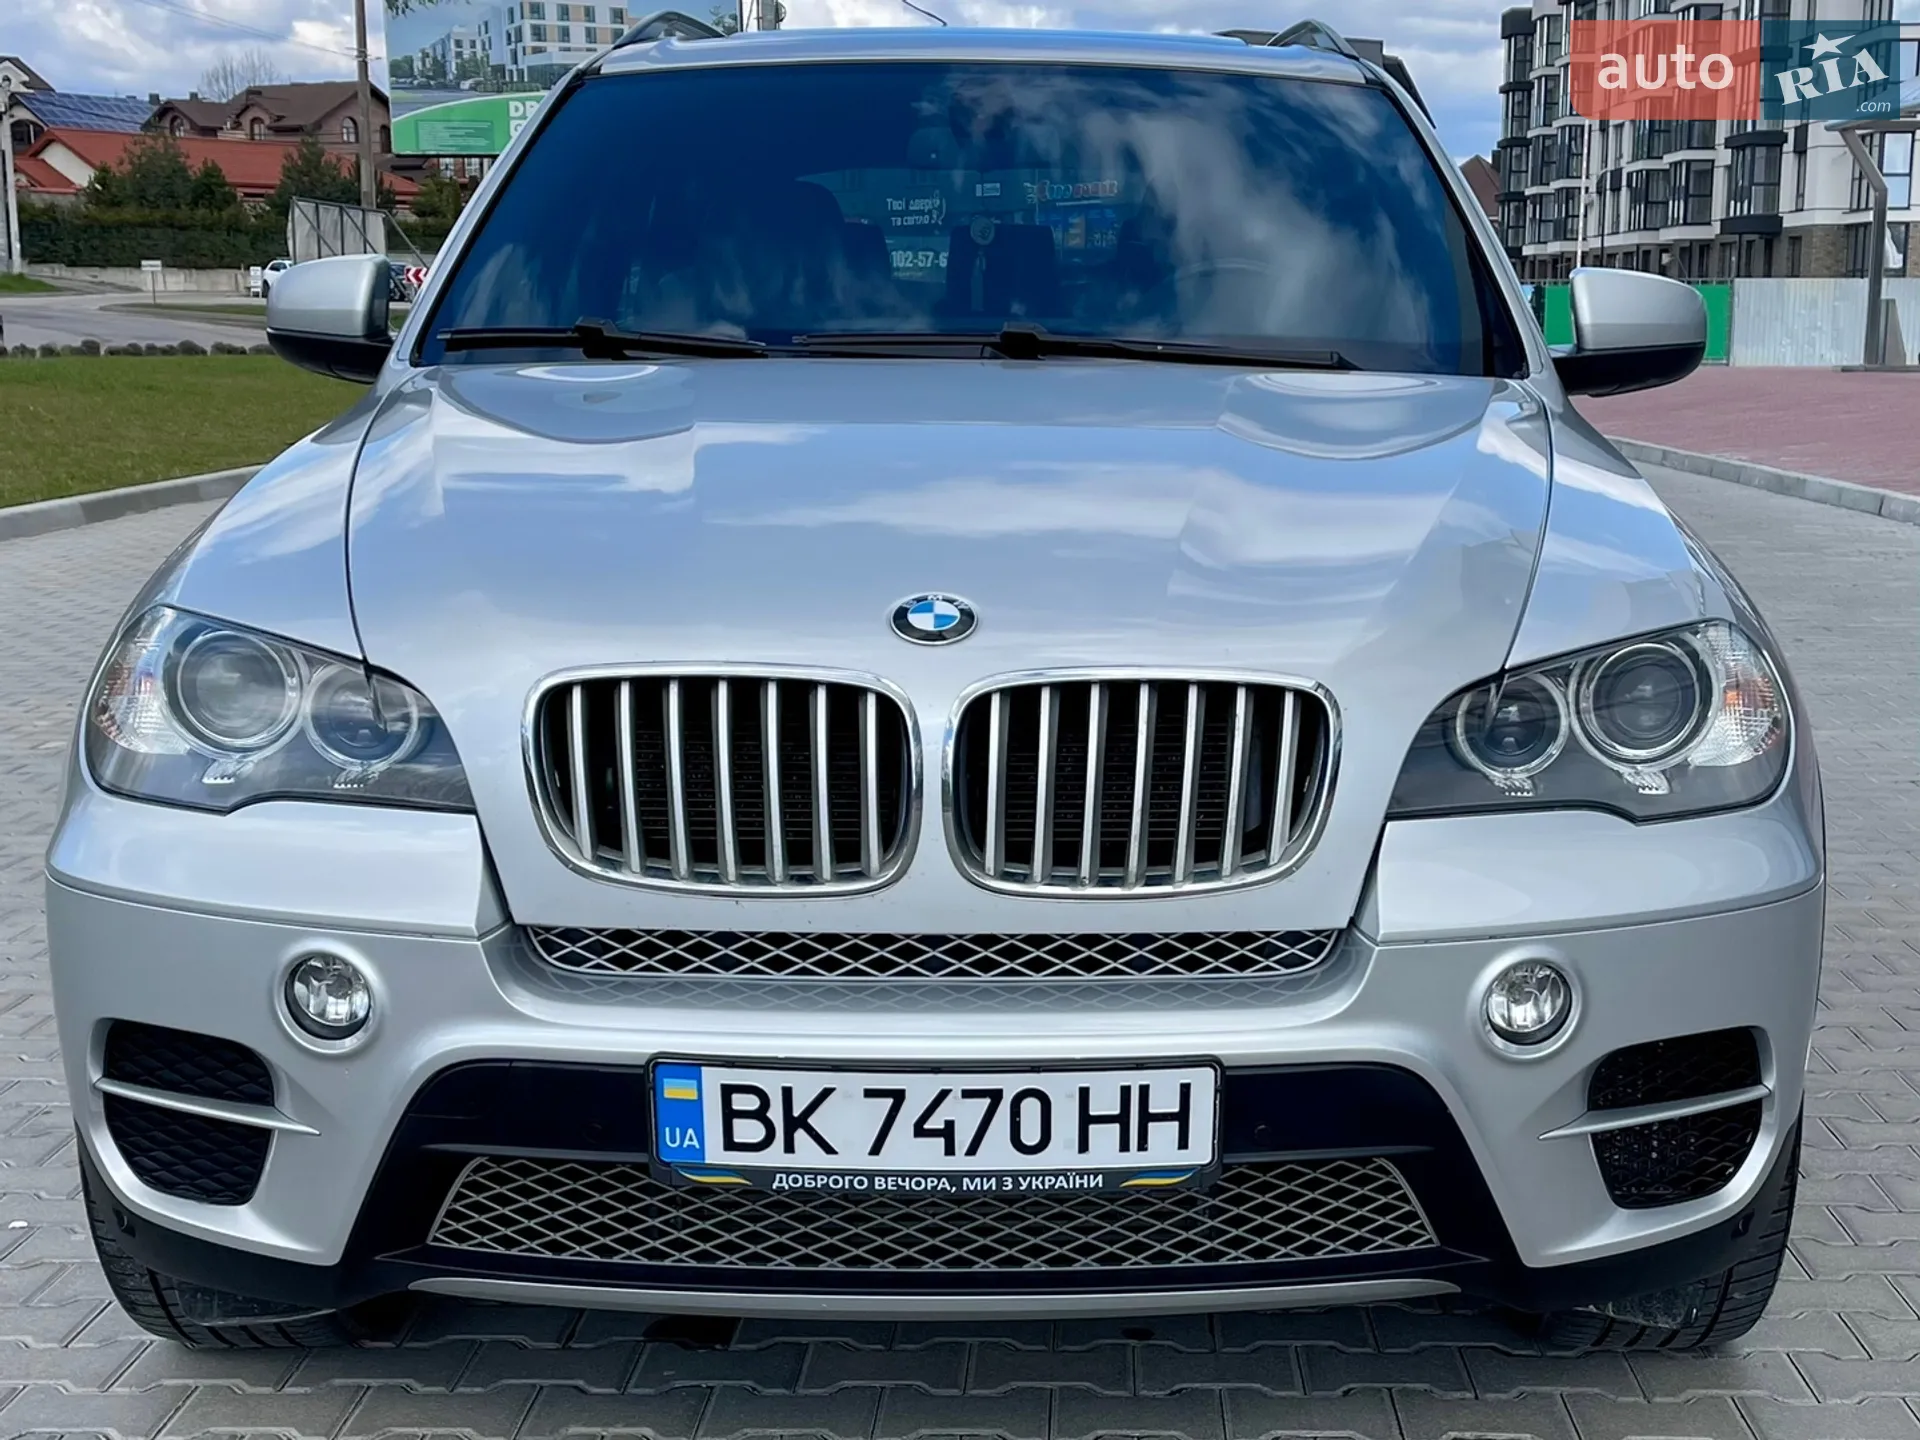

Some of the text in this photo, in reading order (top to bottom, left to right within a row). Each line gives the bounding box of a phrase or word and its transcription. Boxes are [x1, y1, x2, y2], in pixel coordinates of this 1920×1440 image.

[719, 1080, 1193, 1158] BK 7470 HH
[664, 1126, 701, 1150] UA
[772, 1171, 1104, 1193] ДОБРОГО ВЕЧОРА, МИ З УКРАЇНИ
